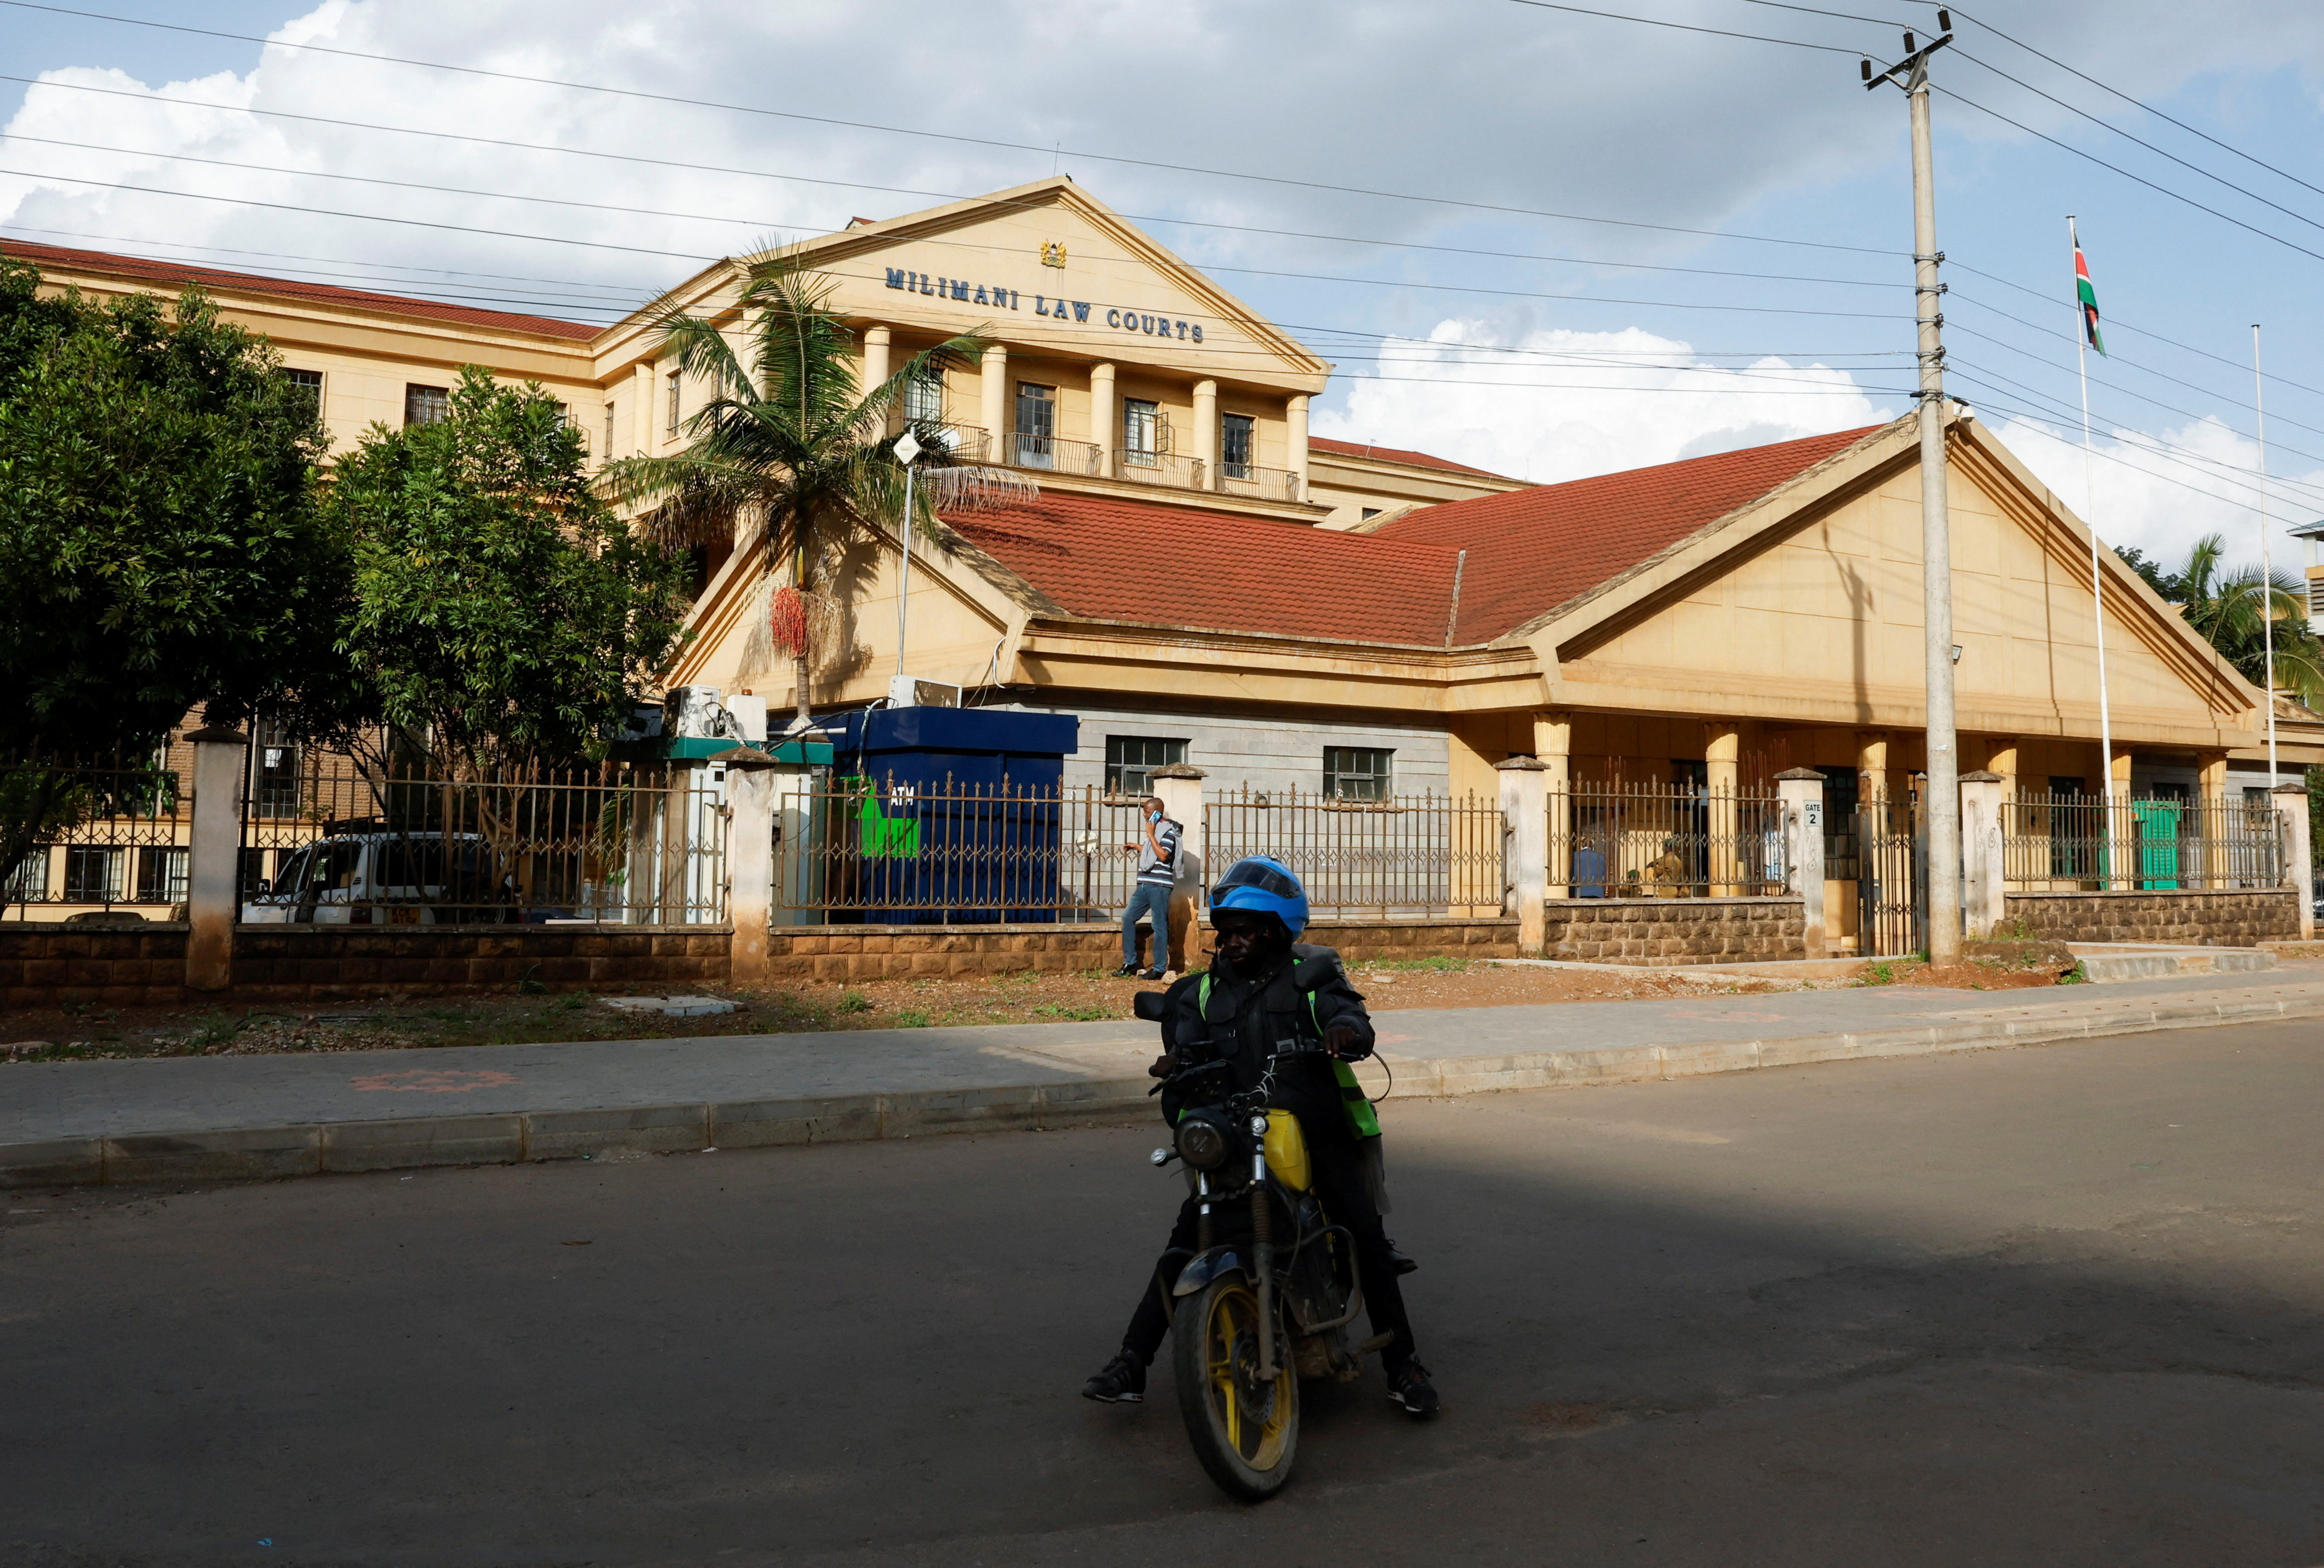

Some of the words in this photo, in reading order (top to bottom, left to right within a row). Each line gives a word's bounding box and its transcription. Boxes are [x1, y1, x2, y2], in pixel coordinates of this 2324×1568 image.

[885, 267, 1019, 310] MILIMANI
[1035, 295, 1091, 323] LAW
[1107, 309, 1204, 344] COURTS
[891, 786, 914, 806] ATM
[1810, 814, 1816, 824] 2
